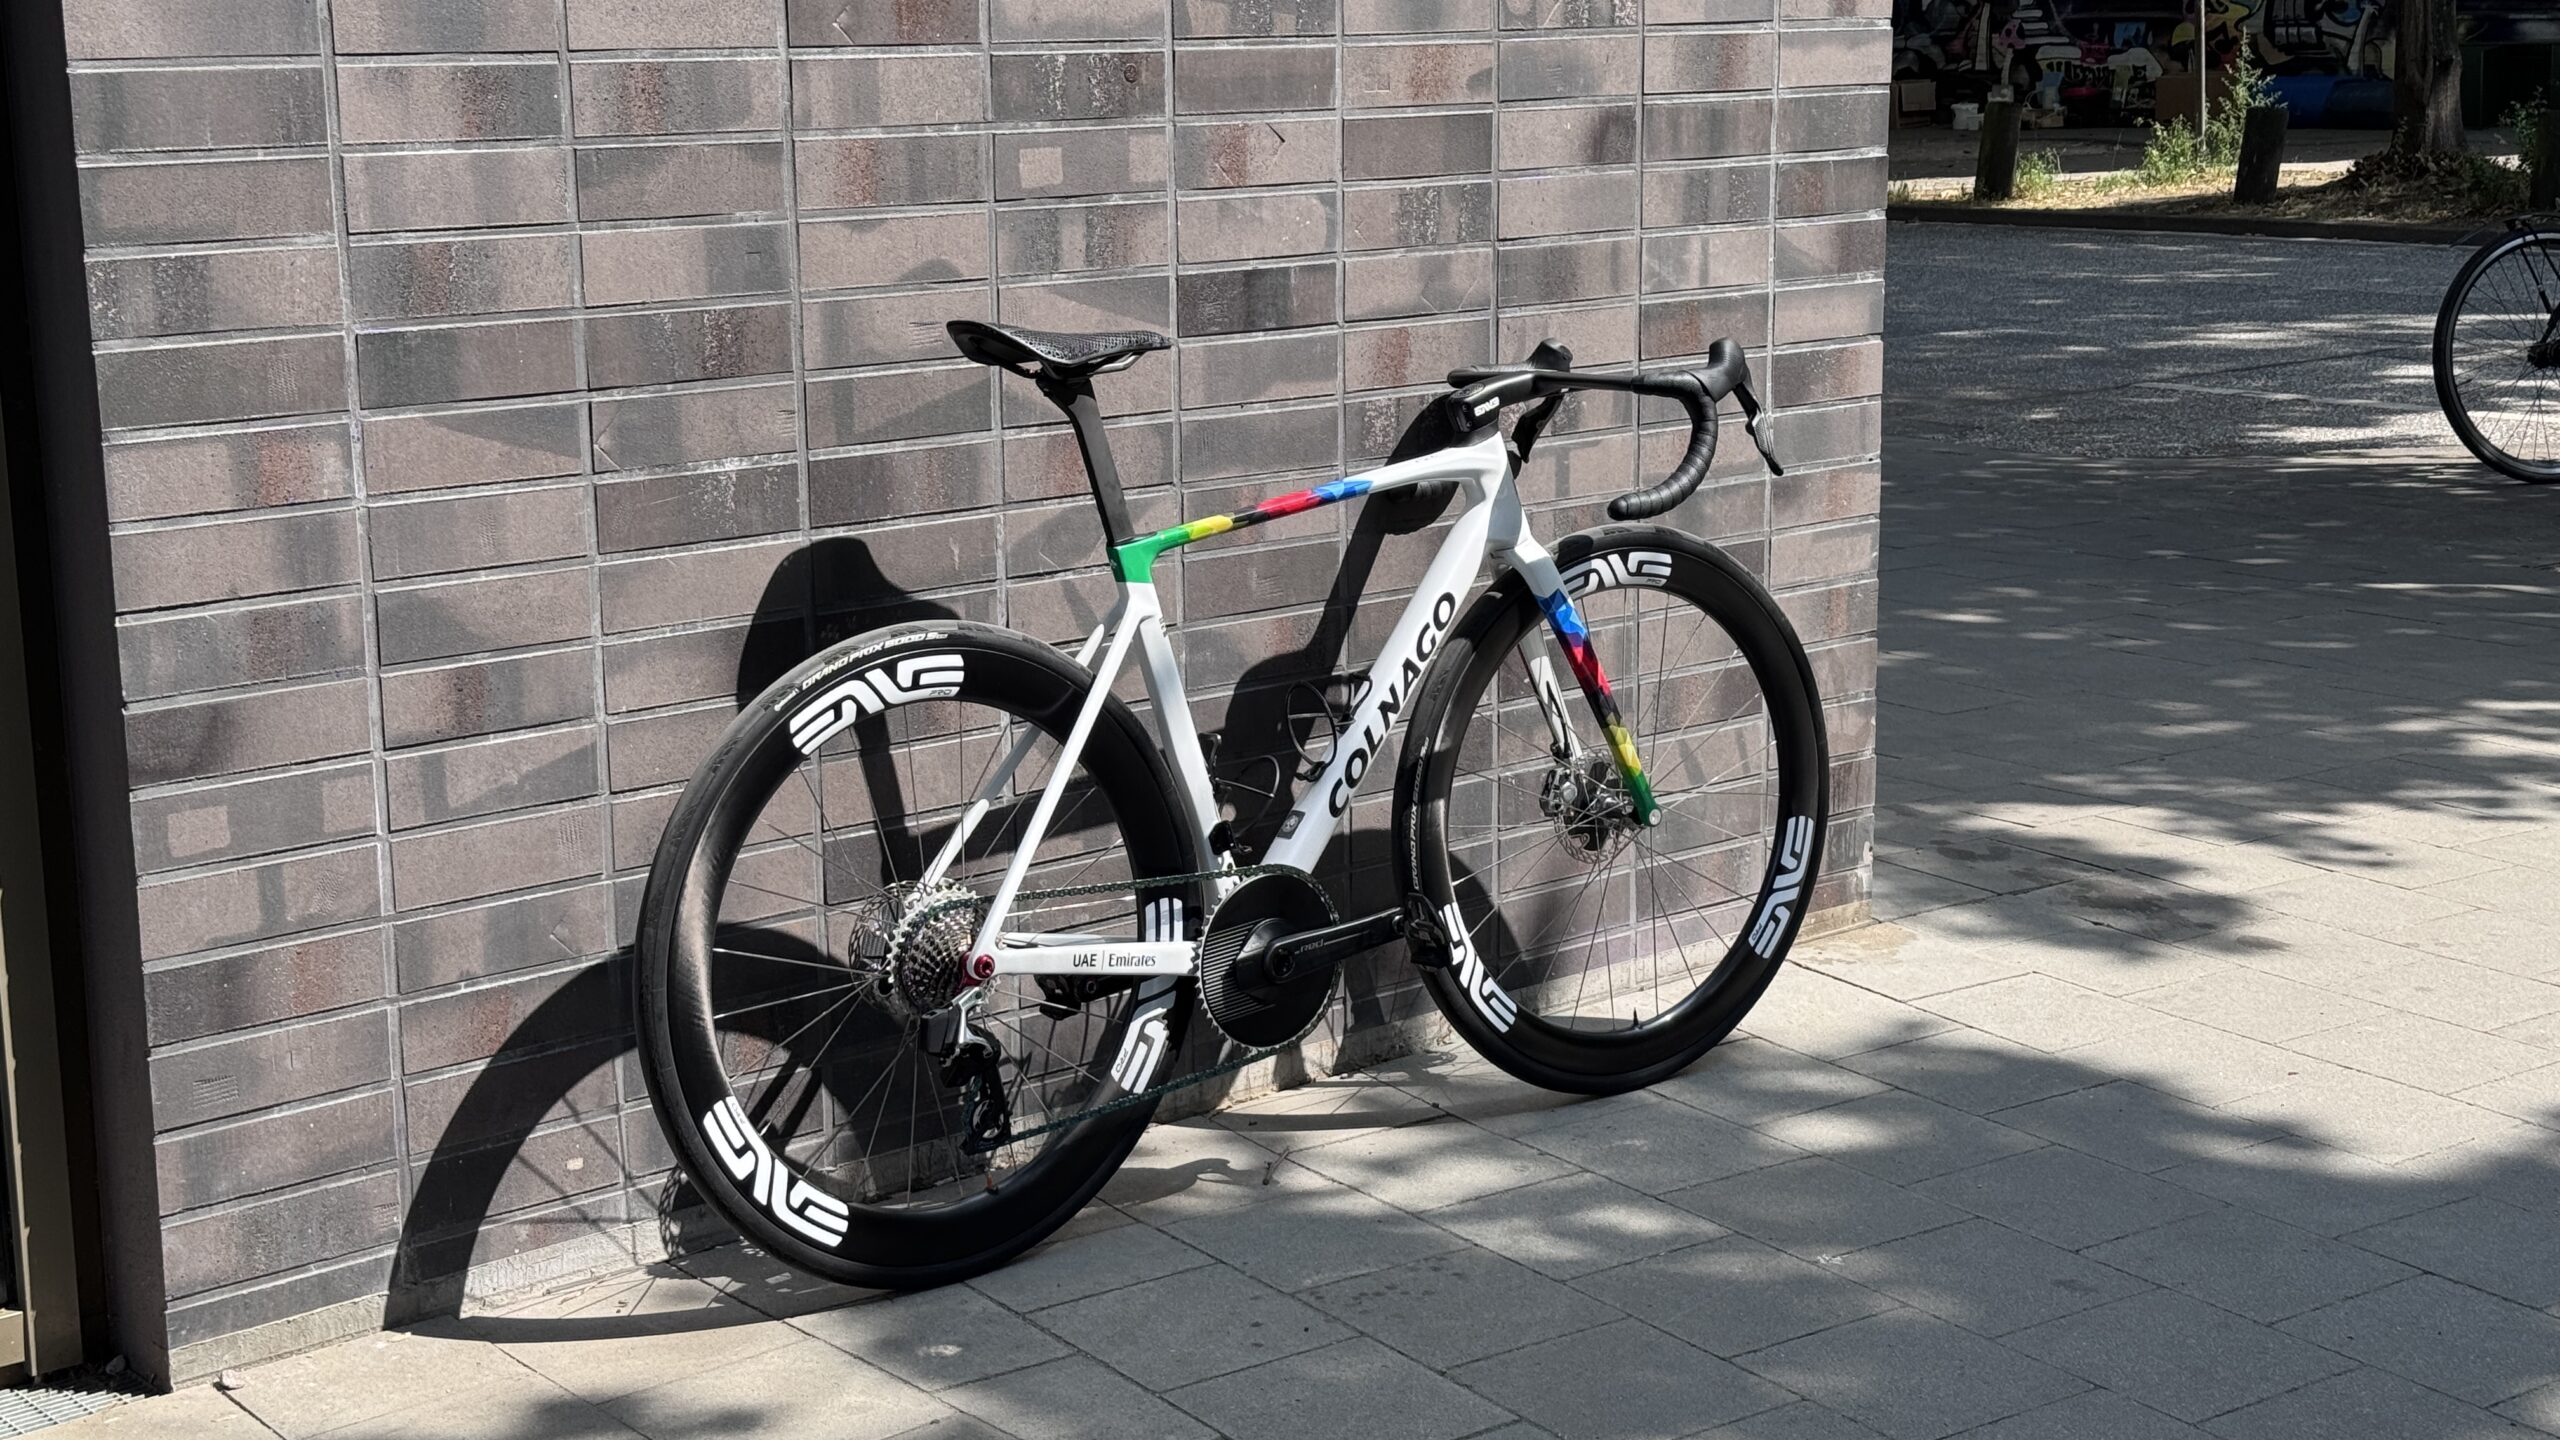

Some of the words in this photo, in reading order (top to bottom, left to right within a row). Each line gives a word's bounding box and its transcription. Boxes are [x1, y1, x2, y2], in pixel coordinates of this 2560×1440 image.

[1474, 396, 1500, 417] ENVE
[802, 656, 849, 690] GRAND
[849, 641, 885, 663] PRIX
[884, 632, 926, 649] 5000
[789, 654, 964, 756] ENVE
[929, 688, 953, 697] PRO
[1328, 592, 1456, 818] COLNAGO
[1409, 802, 1418, 841] PRIX
[1410, 841, 1420, 891] GRAND
[1748, 815, 1814, 959] ENVE
[1073, 953, 1098, 968] UAE
[1108, 952, 1157, 968] Emirates
[702, 1095, 850, 1248] ENVE
